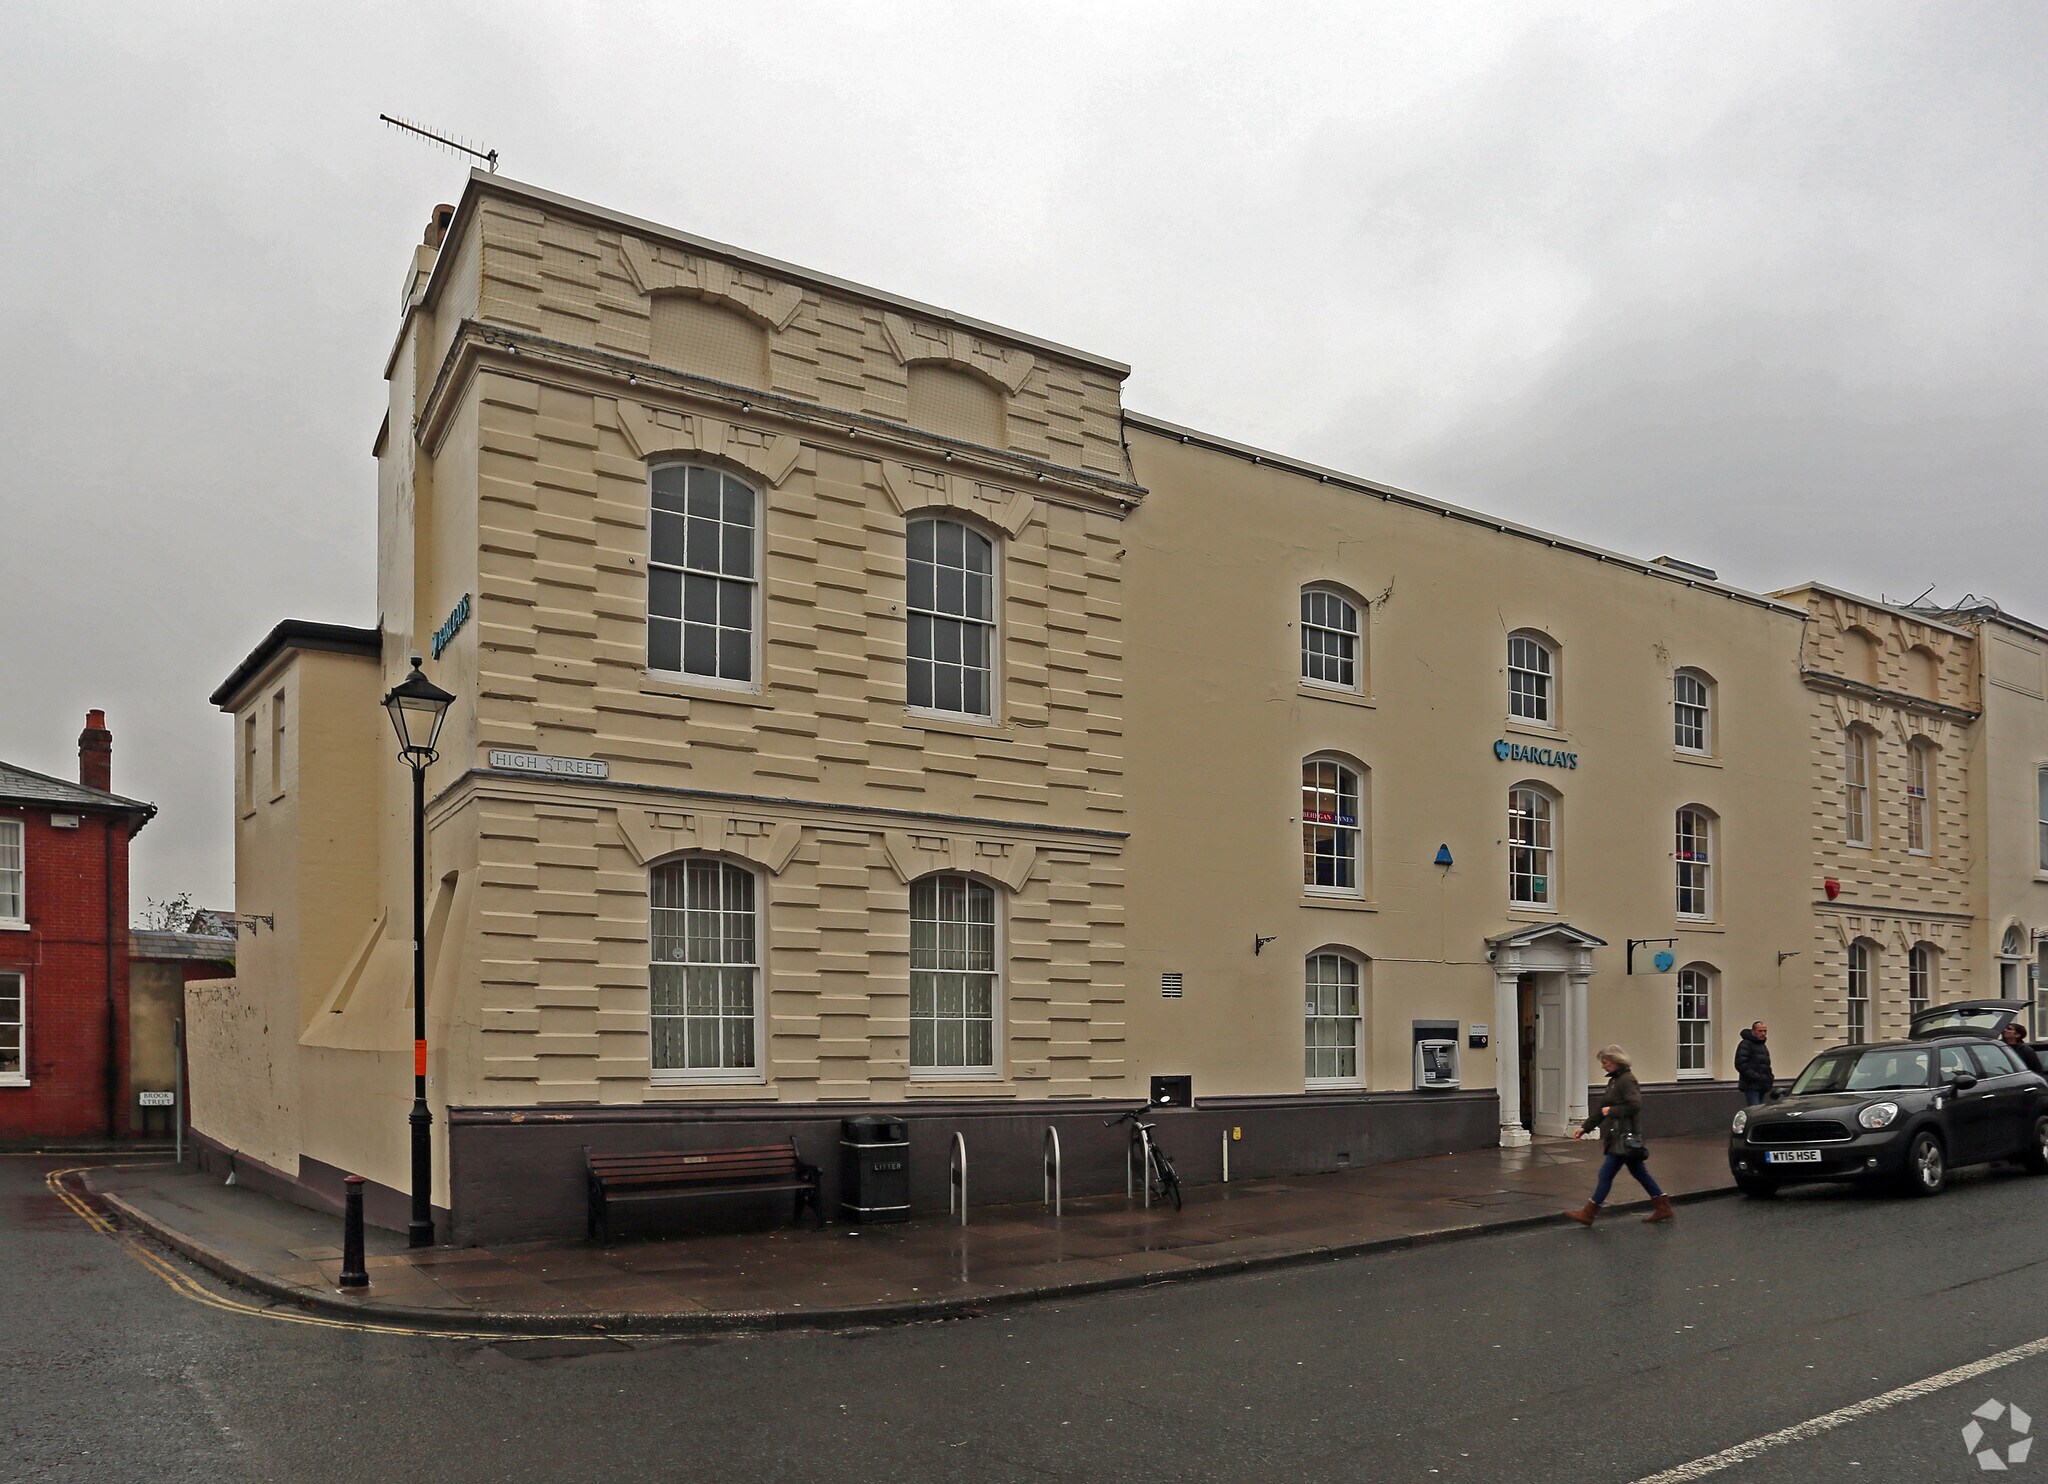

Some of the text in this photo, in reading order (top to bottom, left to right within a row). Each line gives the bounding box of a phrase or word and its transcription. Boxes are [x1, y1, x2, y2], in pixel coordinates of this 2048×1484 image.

[495, 753, 602, 775] HIGH STREET
[1511, 743, 1578, 770] BARCLAYS
[1772, 1150, 1818, 1161] WT15 HSE
[874, 1163, 902, 1171] LITTER
